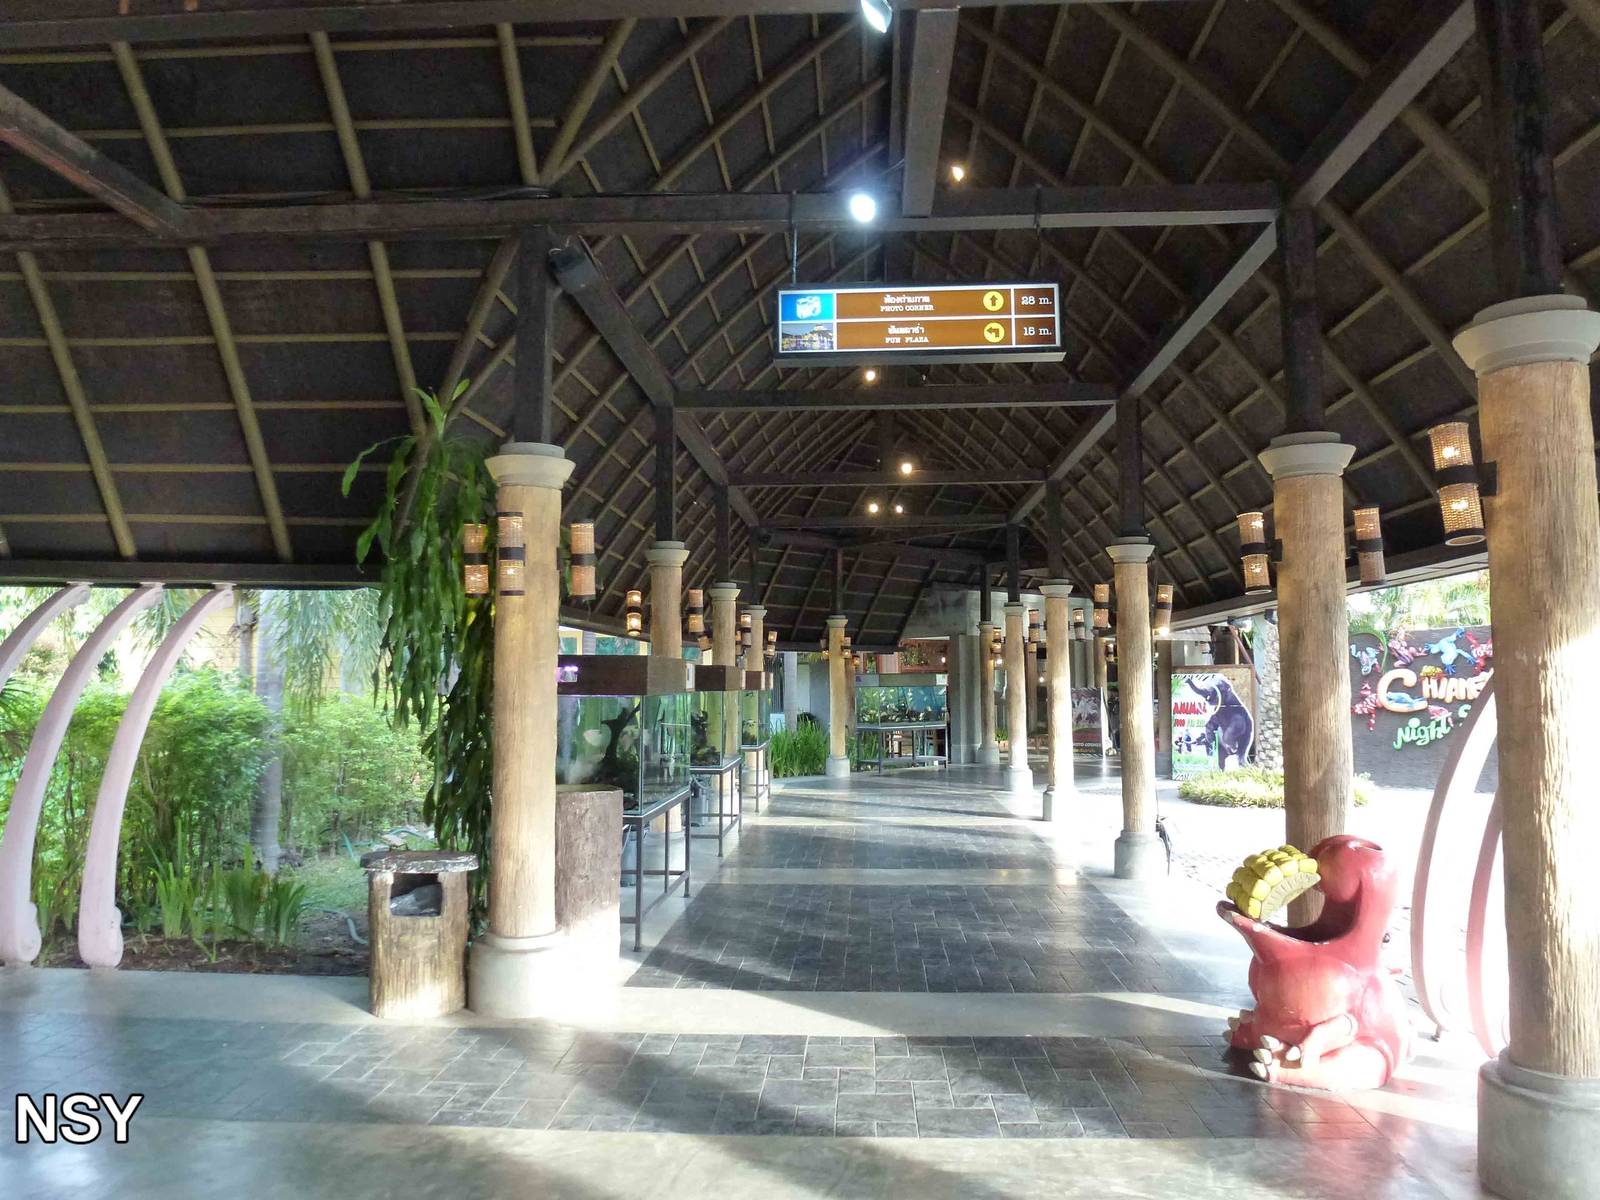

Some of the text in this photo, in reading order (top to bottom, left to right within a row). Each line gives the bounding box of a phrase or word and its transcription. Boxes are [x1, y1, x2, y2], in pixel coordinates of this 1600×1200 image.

[1021, 296, 1053, 305] 28 m.
[1038, 328, 1053, 336] m.
[1393, 713, 1453, 750] Night
